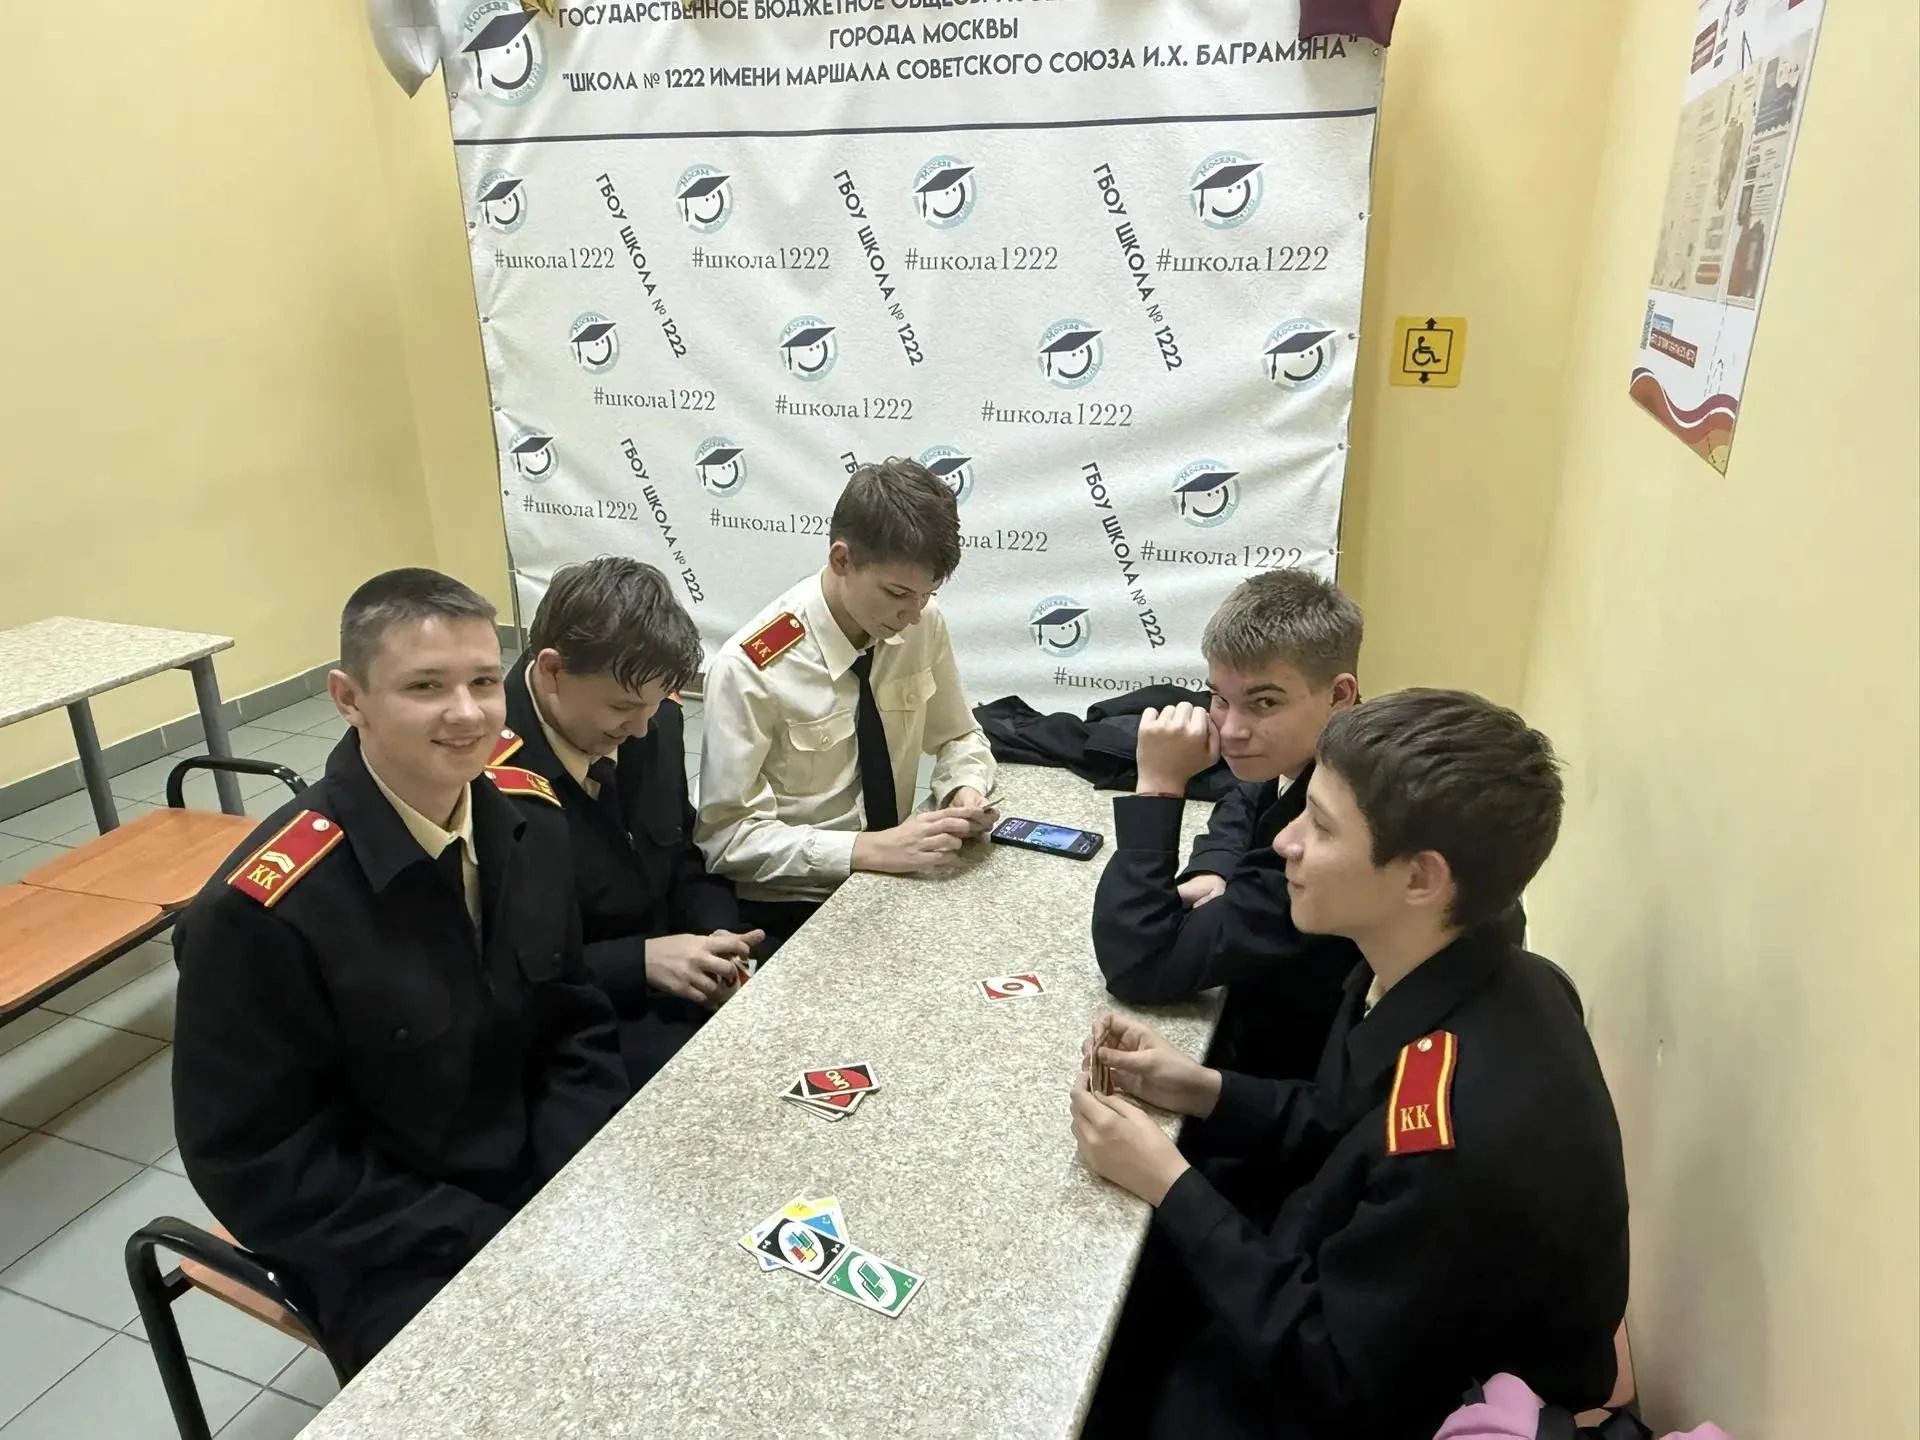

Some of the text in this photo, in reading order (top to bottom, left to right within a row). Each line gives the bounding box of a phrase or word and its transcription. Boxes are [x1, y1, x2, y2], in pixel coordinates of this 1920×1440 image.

[830, 17, 1018, 49] ГОРОДА МОСКВЫ
[562, 72, 638, 92] "ШКОЛА
[665, 68, 705, 88] 1222
[710, 67, 780, 87] ИМЕНИ
[786, 60, 890, 86] МАРШАЛА
[897, 53, 1042, 80] СОВЕТСКОГО
[1049, 48, 1136, 73] СОЮЗА
[1143, 45, 1188, 67] И.Х.
[494, 247, 615, 269] #школа1222
[596, 173, 627, 219] ГБОУ
[620, 225, 656, 296] ШКОЛА
[661, 318, 686, 358] 1222
[692, 246, 831, 270] #школа1222
[833, 170, 867, 219] ГБОУ
[858, 225, 895, 301] ШКОЛА
[898, 323, 923, 366] 1222
[904, 246, 1058, 271] #школа1222
[1093, 163, 1127, 215] ГБОУ
[1115, 222, 1155, 302] ШКОЛА
[1154, 325, 1182, 371] 1222
[1155, 246, 1328, 272] #школа1222
[593, 386, 715, 411] #школа1222
[775, 394, 912, 420] #школа1222
[981, 400, 1132, 427] #школа1222
[840, 451, 860, 474] ГБ
[523, 494, 639, 520] #школа1222
[621, 438, 649, 479] ГБОУ
[643, 485, 677, 547] ШКОЛА
[681, 568, 704, 604] 1222
[1082, 462, 1112, 509] ГБОУ
[1102, 514, 1142, 586] ШКОЛА
[1139, 608, 1166, 649] 1222
[247, 863, 282, 890] КК
[1400, 1104, 1432, 1132] КК
